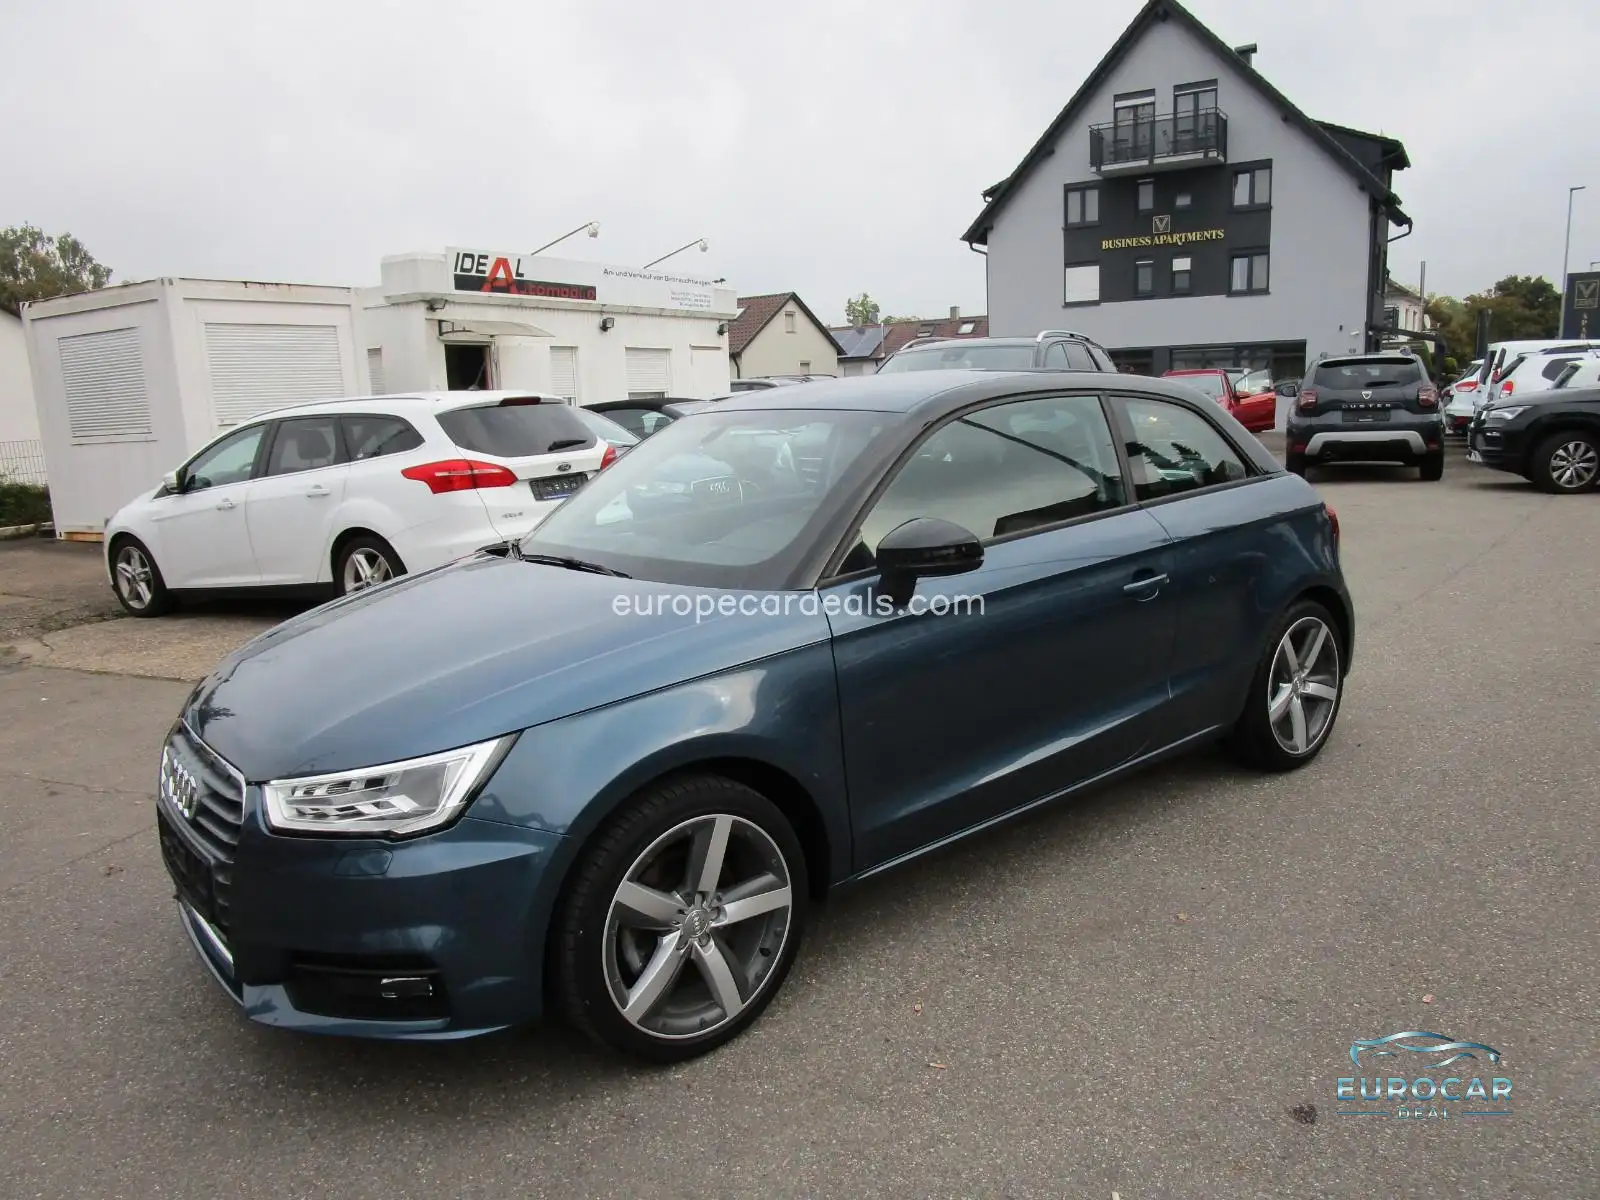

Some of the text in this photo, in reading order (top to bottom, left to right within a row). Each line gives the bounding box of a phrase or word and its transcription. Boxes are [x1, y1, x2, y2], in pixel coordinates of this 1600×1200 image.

[1102, 229, 1225, 250] BUSINESS APARTMENTS
[454, 252, 524, 292] IDEAL
